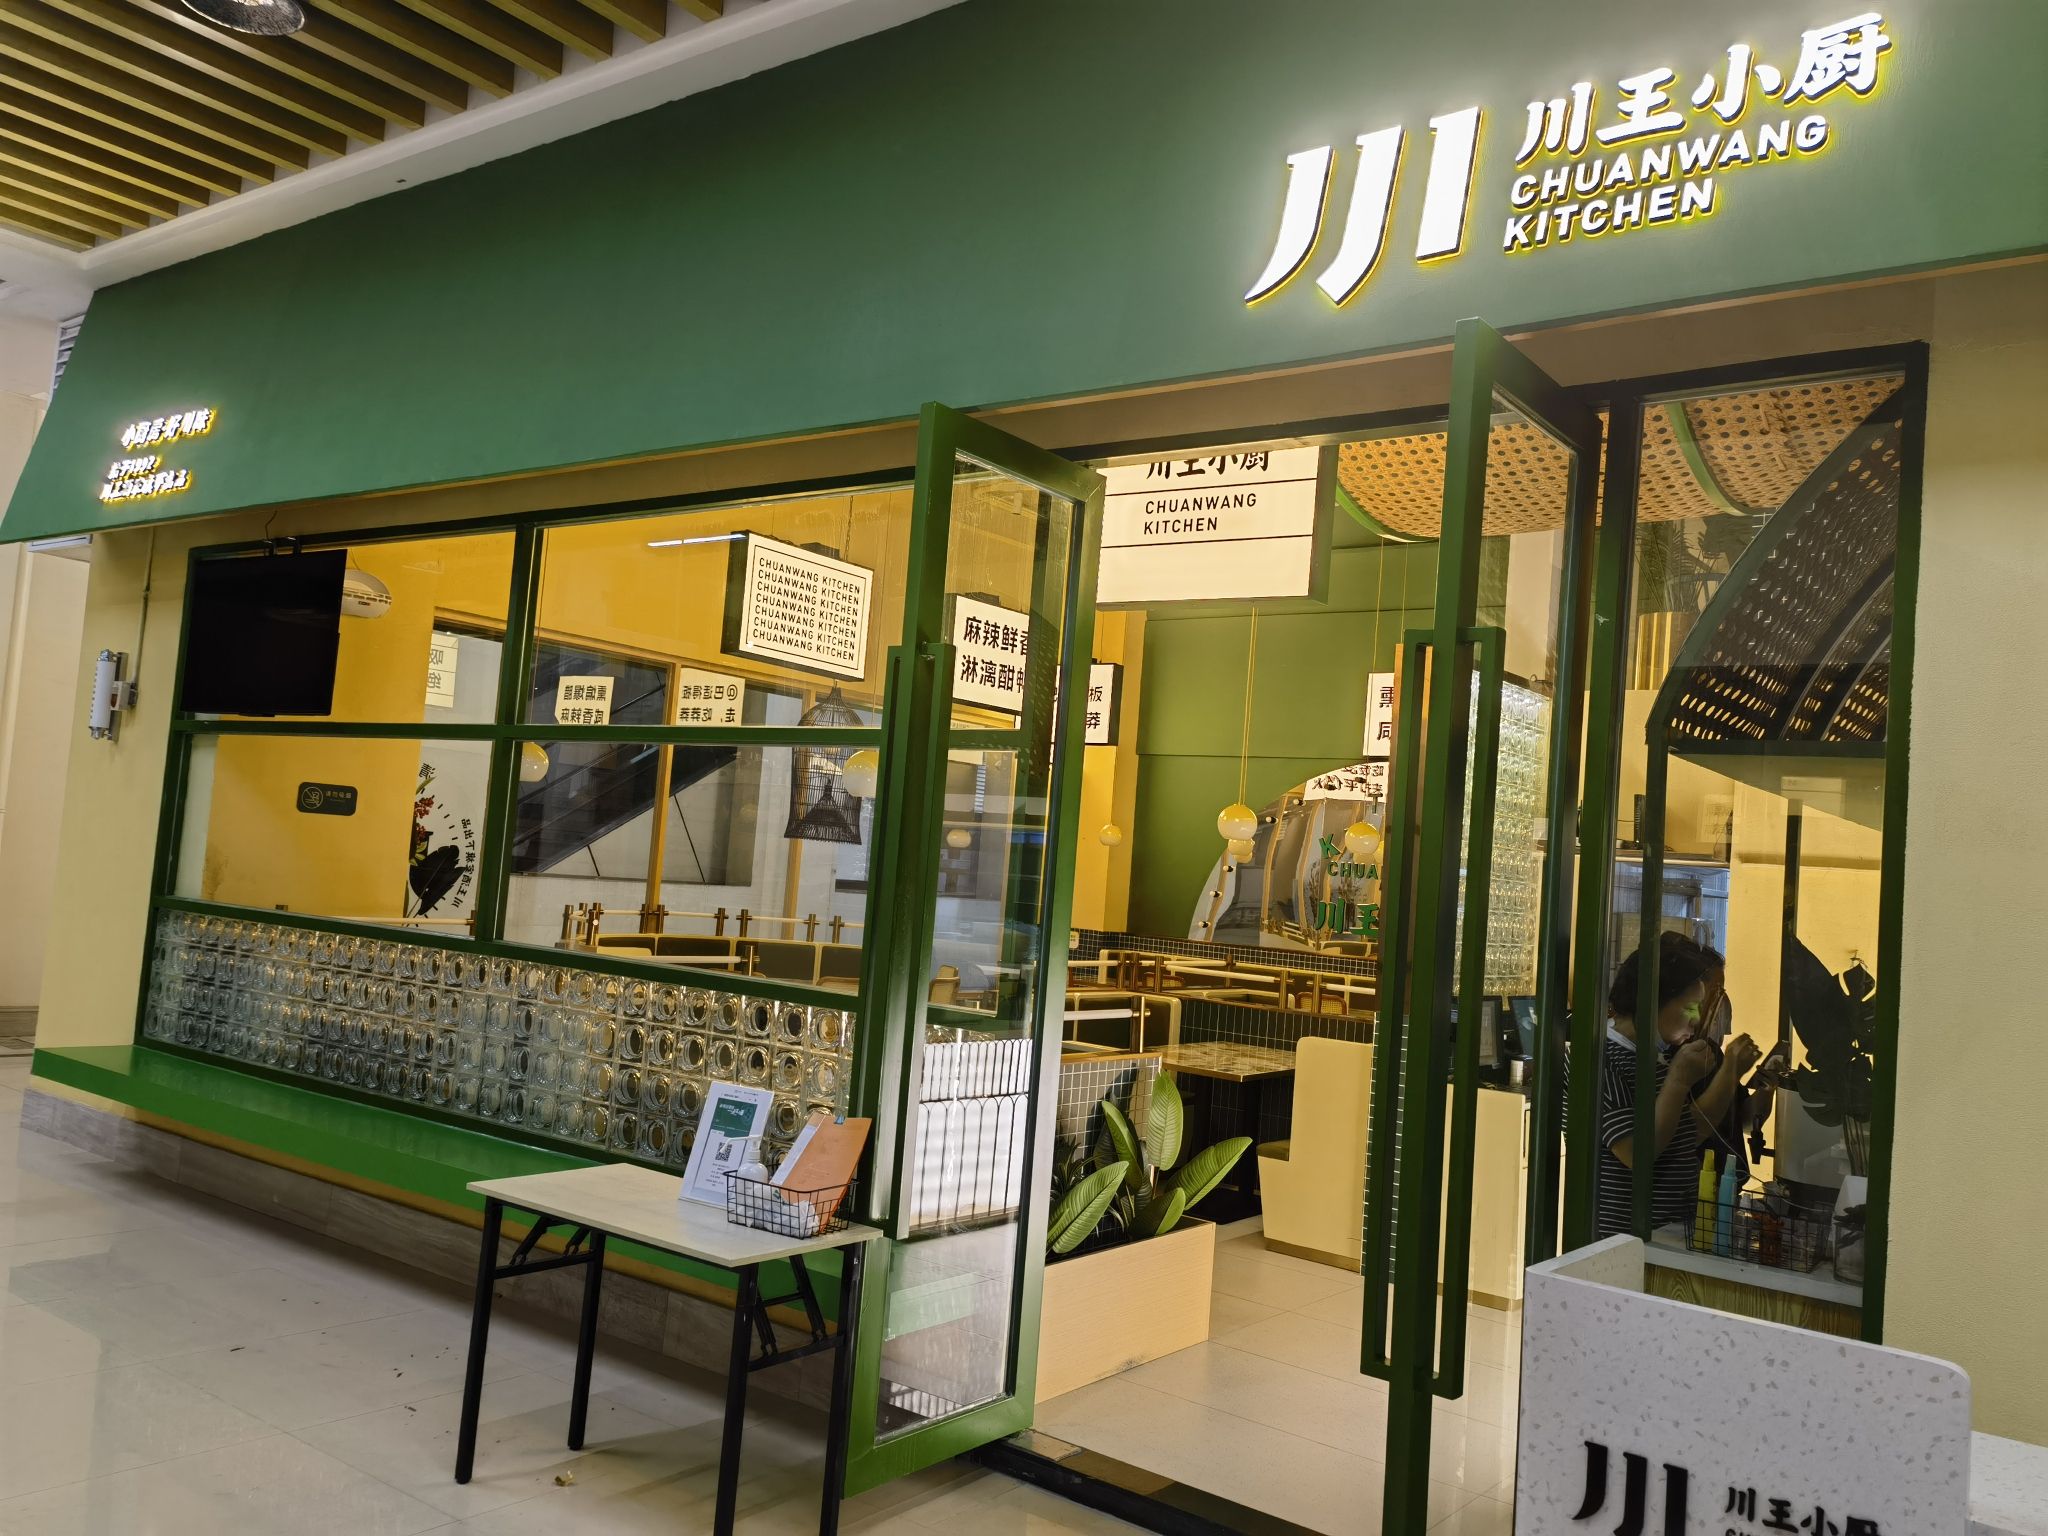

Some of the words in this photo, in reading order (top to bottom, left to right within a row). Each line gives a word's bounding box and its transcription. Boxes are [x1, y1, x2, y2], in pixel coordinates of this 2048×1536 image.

[1516, 13, 1892, 165] 川王小厨
[1509, 115, 1831, 208] CHUANWANG
[1504, 178, 1717, 253] KITCHEN
[1145, 493, 1257, 514] CHUANWANG
[1144, 517, 1218, 535] KITCHEN
[758, 569, 818, 594] CHUANWANG
[821, 587, 859, 605] KITCHEN
[760, 557, 818, 582] CHUANWANG
[822, 576, 860, 594] KITCHEN
[756, 593, 816, 616] CHUANWANG
[819, 610, 857, 628] KITCHEN
[757, 581, 816, 605] CHUANWANG
[820, 599, 858, 616] KITCHEN
[754, 617, 814, 640] CHUANWANG
[817, 633, 855, 650] KITCHEN
[755, 605, 814, 628] CHUANWANG
[818, 622, 856, 639] KITCHEN
[752, 628, 812, 651] CHUANWANG
[816, 645, 854, 661] KITCHEN
